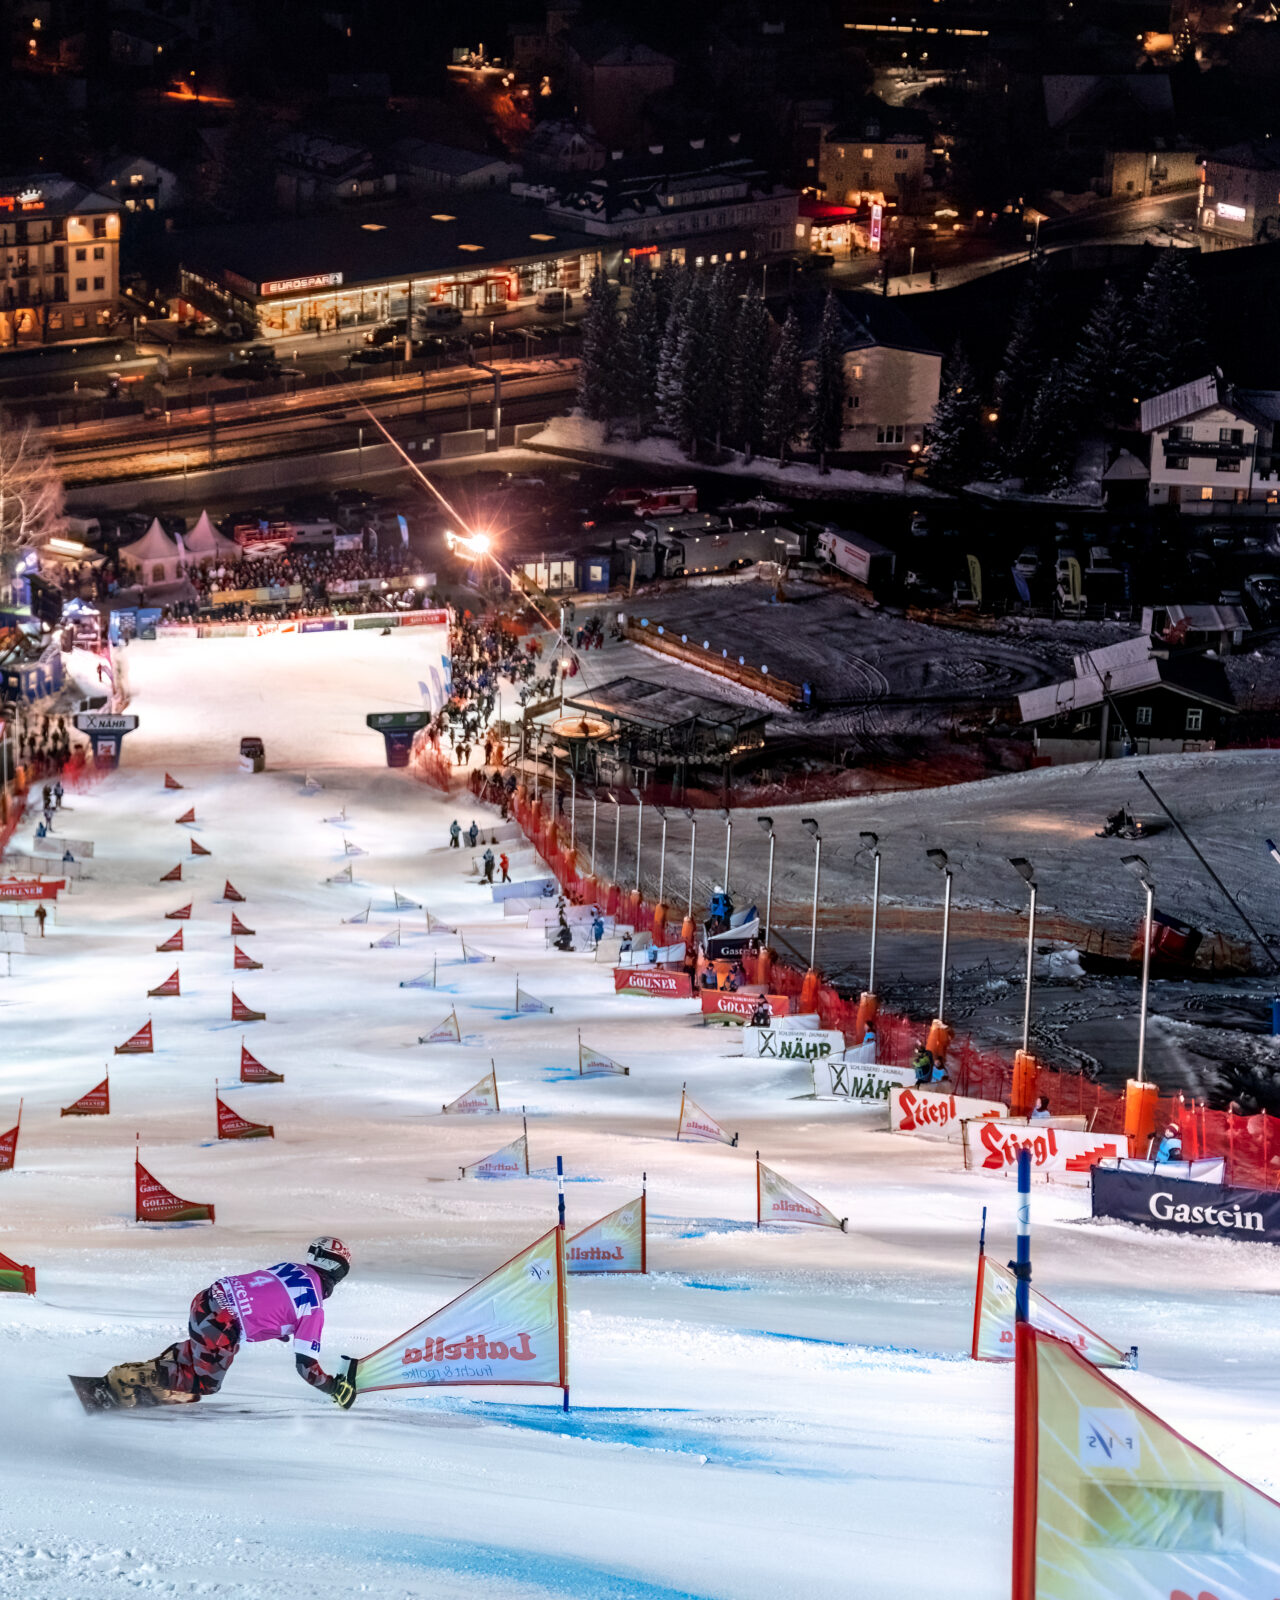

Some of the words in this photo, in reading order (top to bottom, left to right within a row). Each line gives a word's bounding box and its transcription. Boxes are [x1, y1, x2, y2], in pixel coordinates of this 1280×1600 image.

[269, 276, 329, 292] EUROSPAR
[628, 975, 677, 990] GOLLNER
[779, 1037, 832, 1059] NÄHR
[898, 1089, 956, 1130] Stiegl
[980, 1121, 1058, 1169] Stiegl
[1148, 1191, 1266, 1232] Gastein
